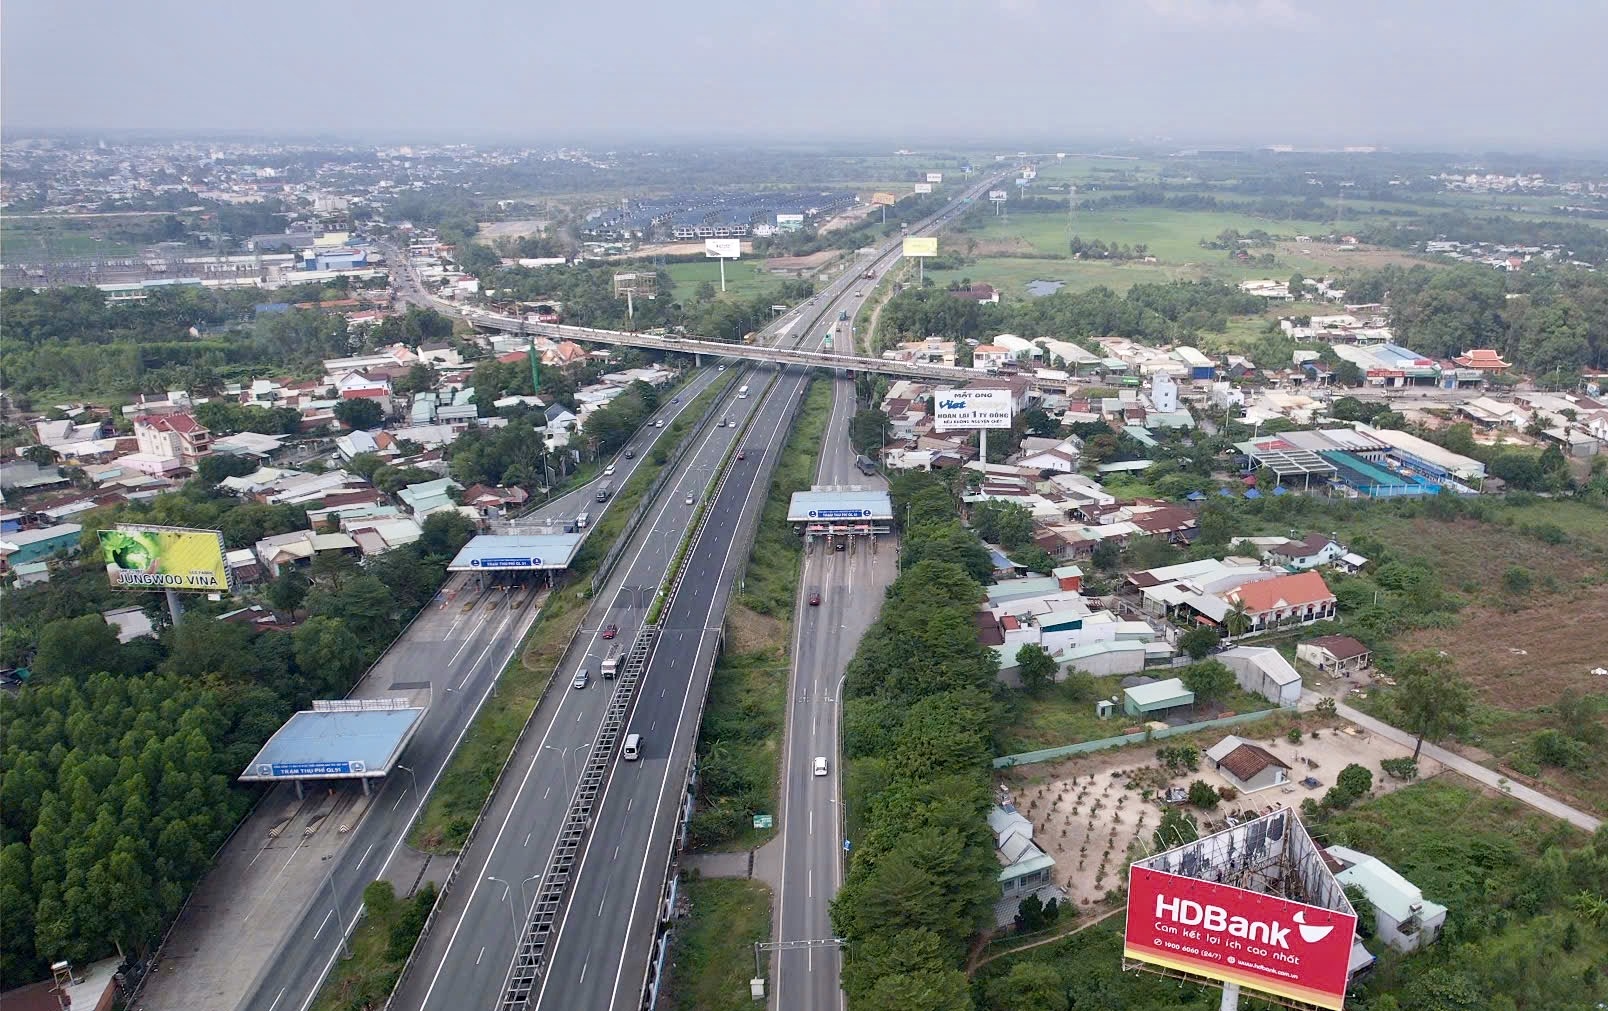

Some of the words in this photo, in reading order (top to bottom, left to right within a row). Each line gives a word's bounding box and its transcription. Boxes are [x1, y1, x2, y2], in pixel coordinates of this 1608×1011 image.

[117, 573, 182, 585] JUNGWOO
[186, 575, 218, 586] VINA
[1155, 894, 1291, 950] HDBank
[1154, 922, 1178, 935] Cam
[1183, 927, 1201, 940] kết
[1206, 934, 1221, 945] lợi
[1225, 937, 1241, 950] ích
[1247, 945, 1267, 956] cao
[1273, 952, 1299, 965] nhất
[1164, 941, 1180, 950] 1900
[1182, 945, 1199, 955] 6060
[1201, 948, 1222, 960] (24/7)
[1237, 959, 1299, 979] www.hdbank.com.vn
